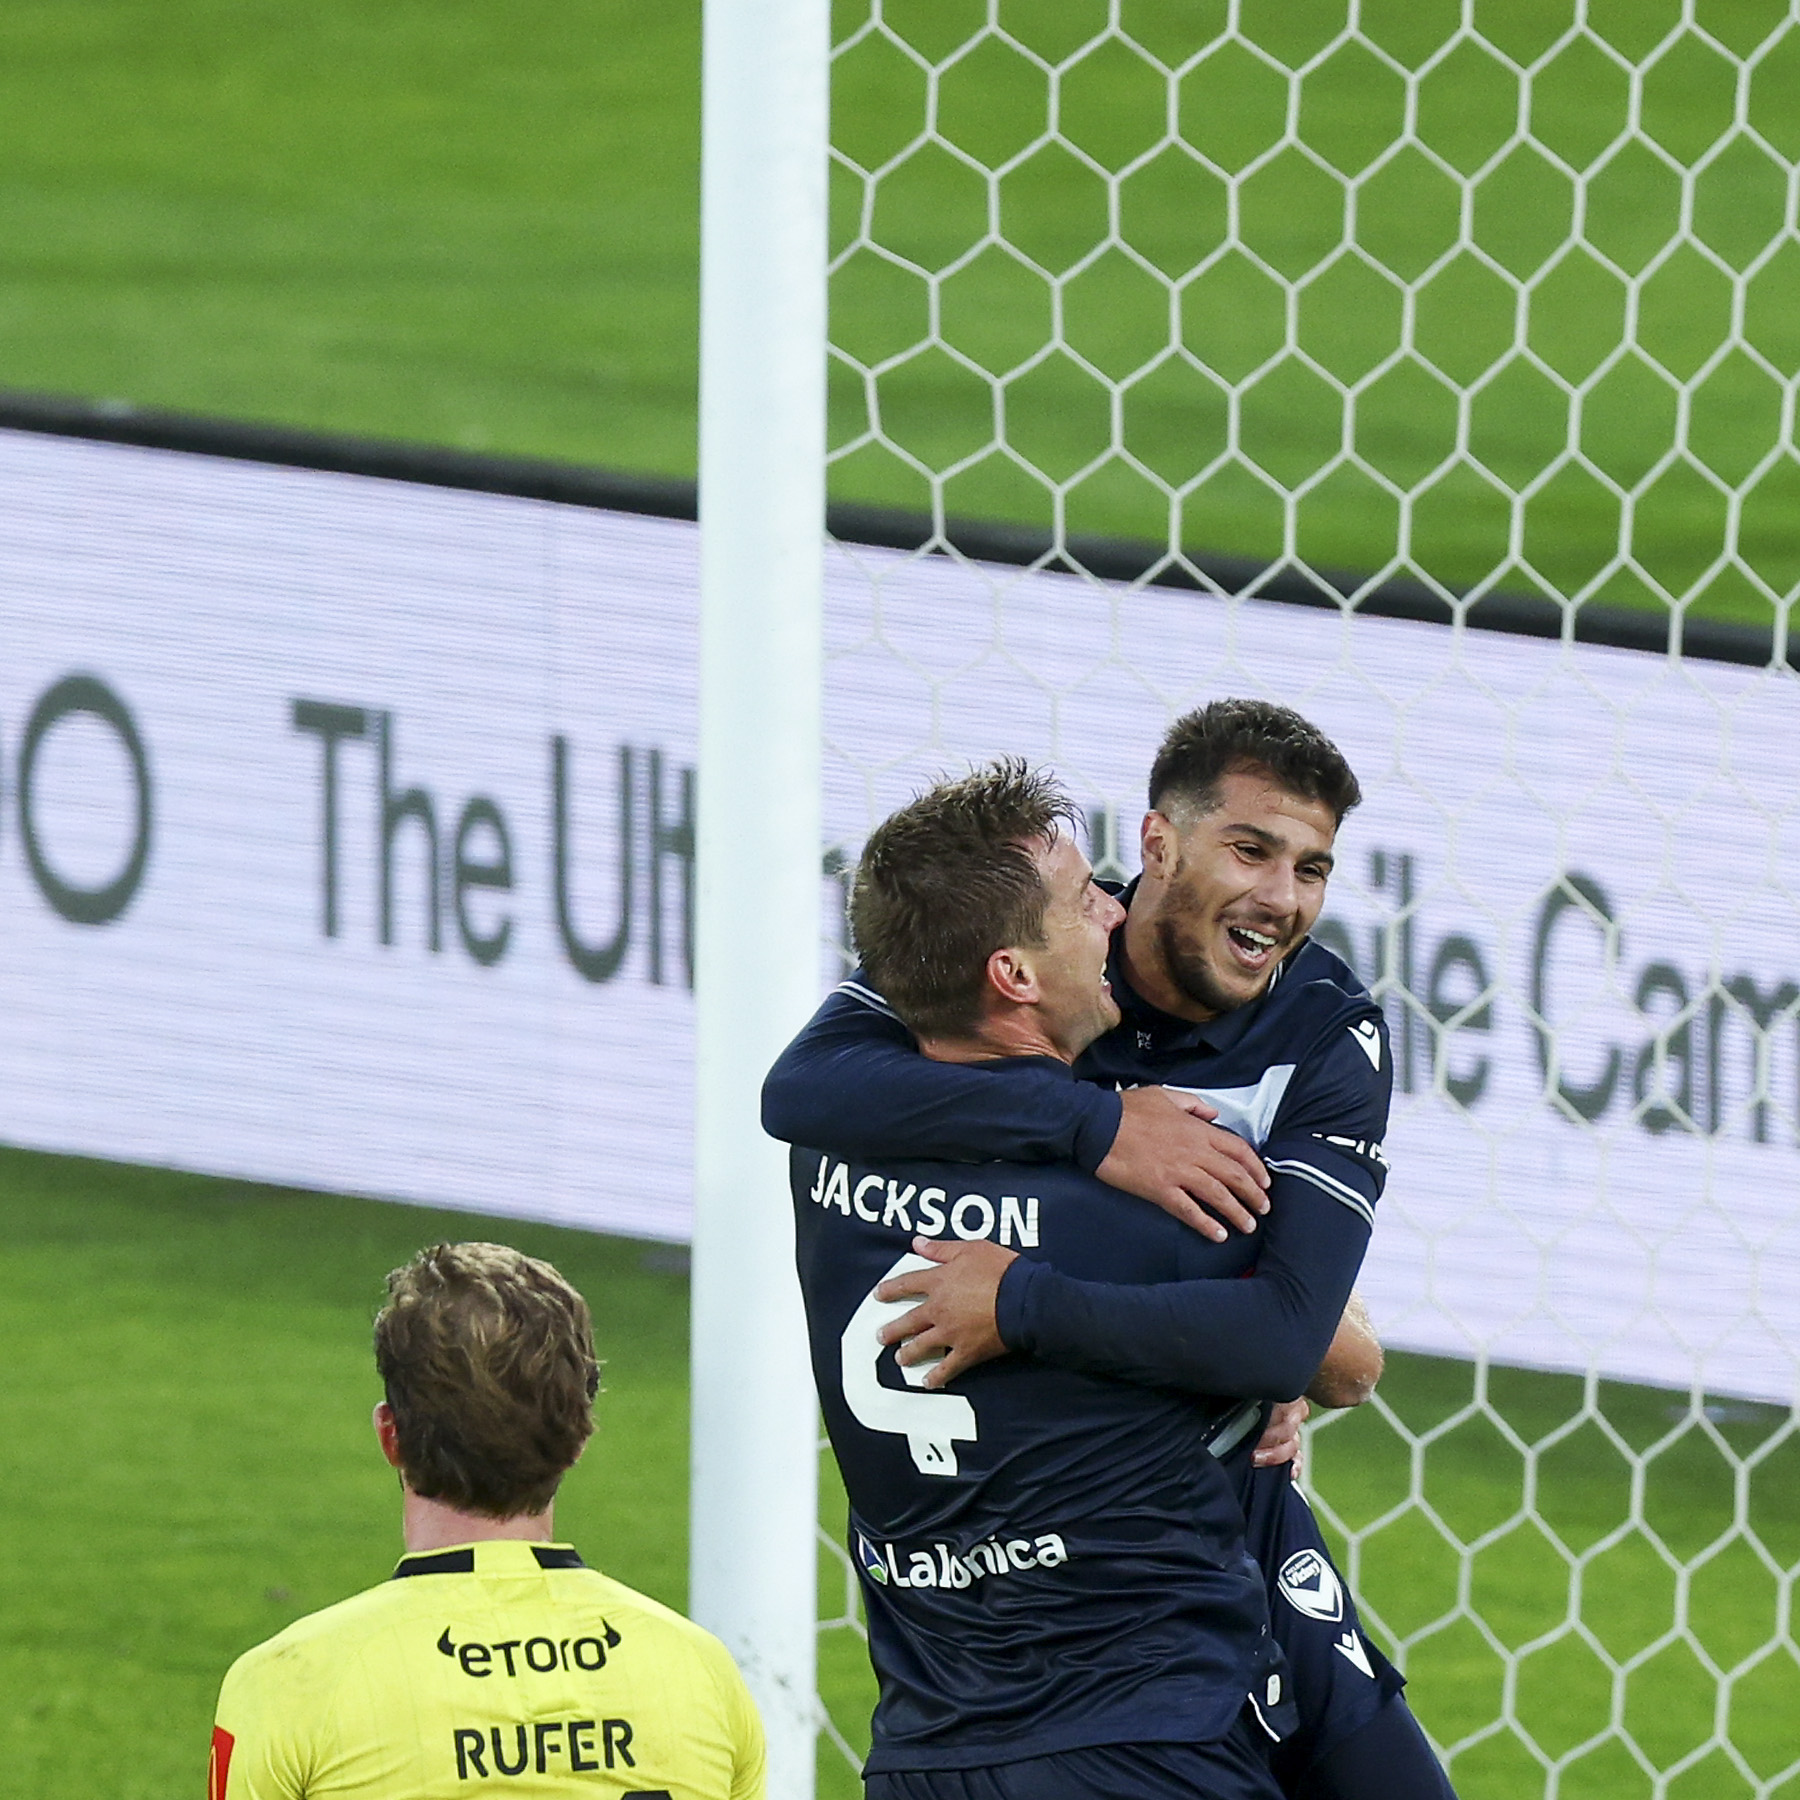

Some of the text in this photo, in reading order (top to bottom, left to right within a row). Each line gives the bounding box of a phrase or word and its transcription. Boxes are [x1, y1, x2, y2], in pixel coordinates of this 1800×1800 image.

[290, 695, 516, 968] The
[811, 1155, 1040, 1247] JACKSON
[840, 1252, 978, 1476] 4
[453, 1718, 636, 1780] RUFER
